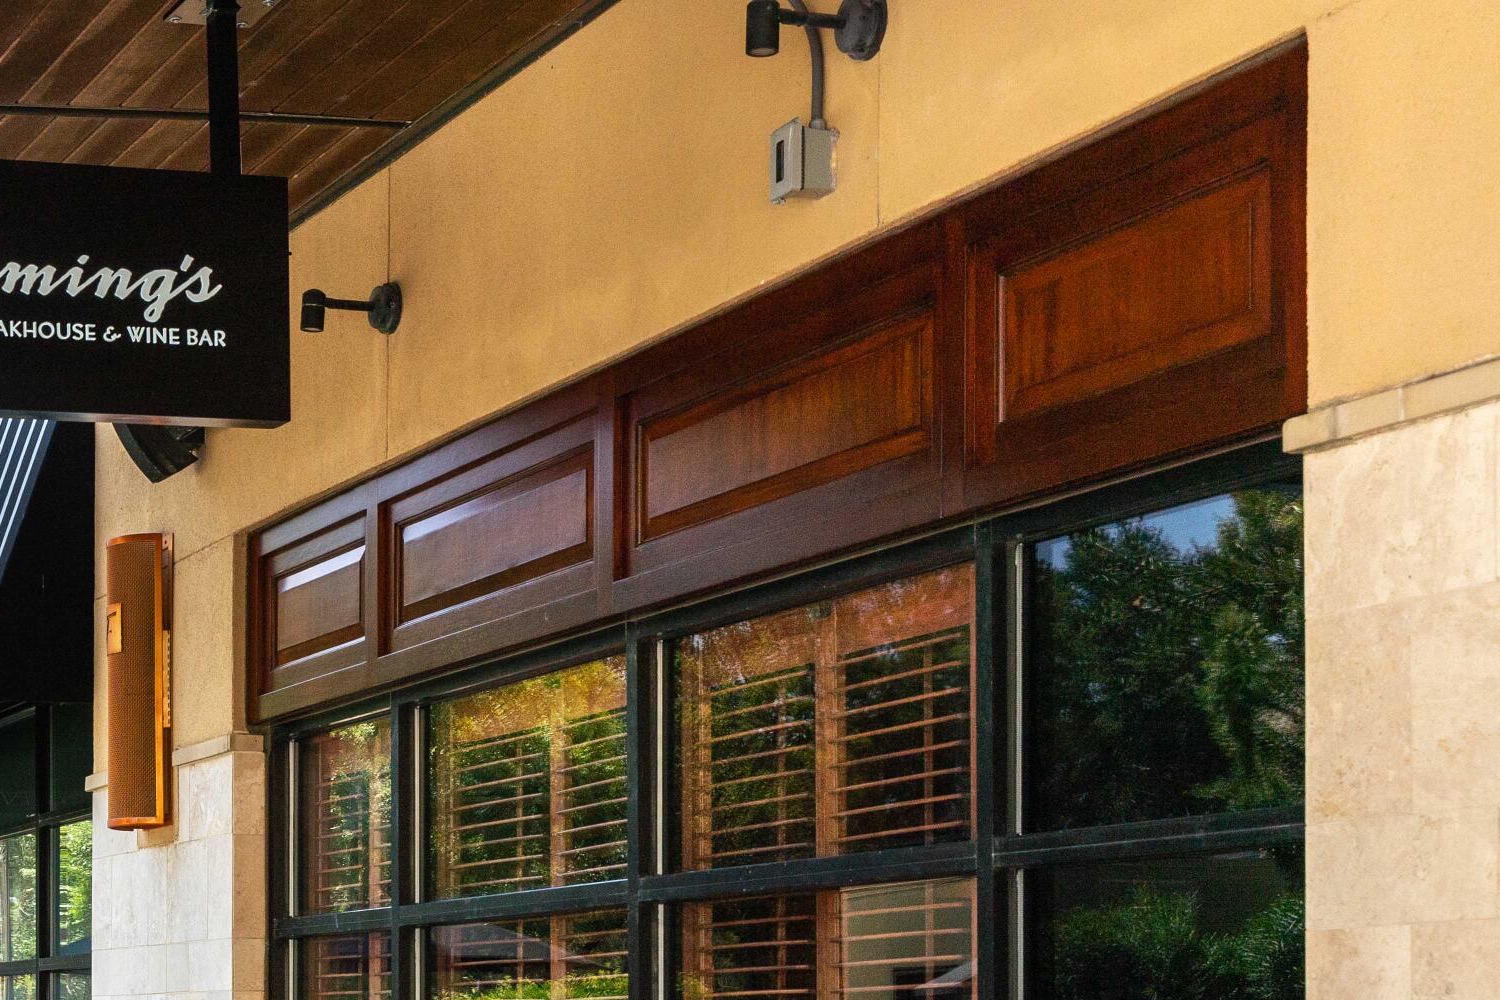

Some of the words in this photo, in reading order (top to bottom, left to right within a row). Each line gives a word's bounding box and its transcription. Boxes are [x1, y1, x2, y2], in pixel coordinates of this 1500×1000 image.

[103, 326, 122, 342] &
[127, 326, 180, 345] WINE
[187, 328, 226, 347] BAR
